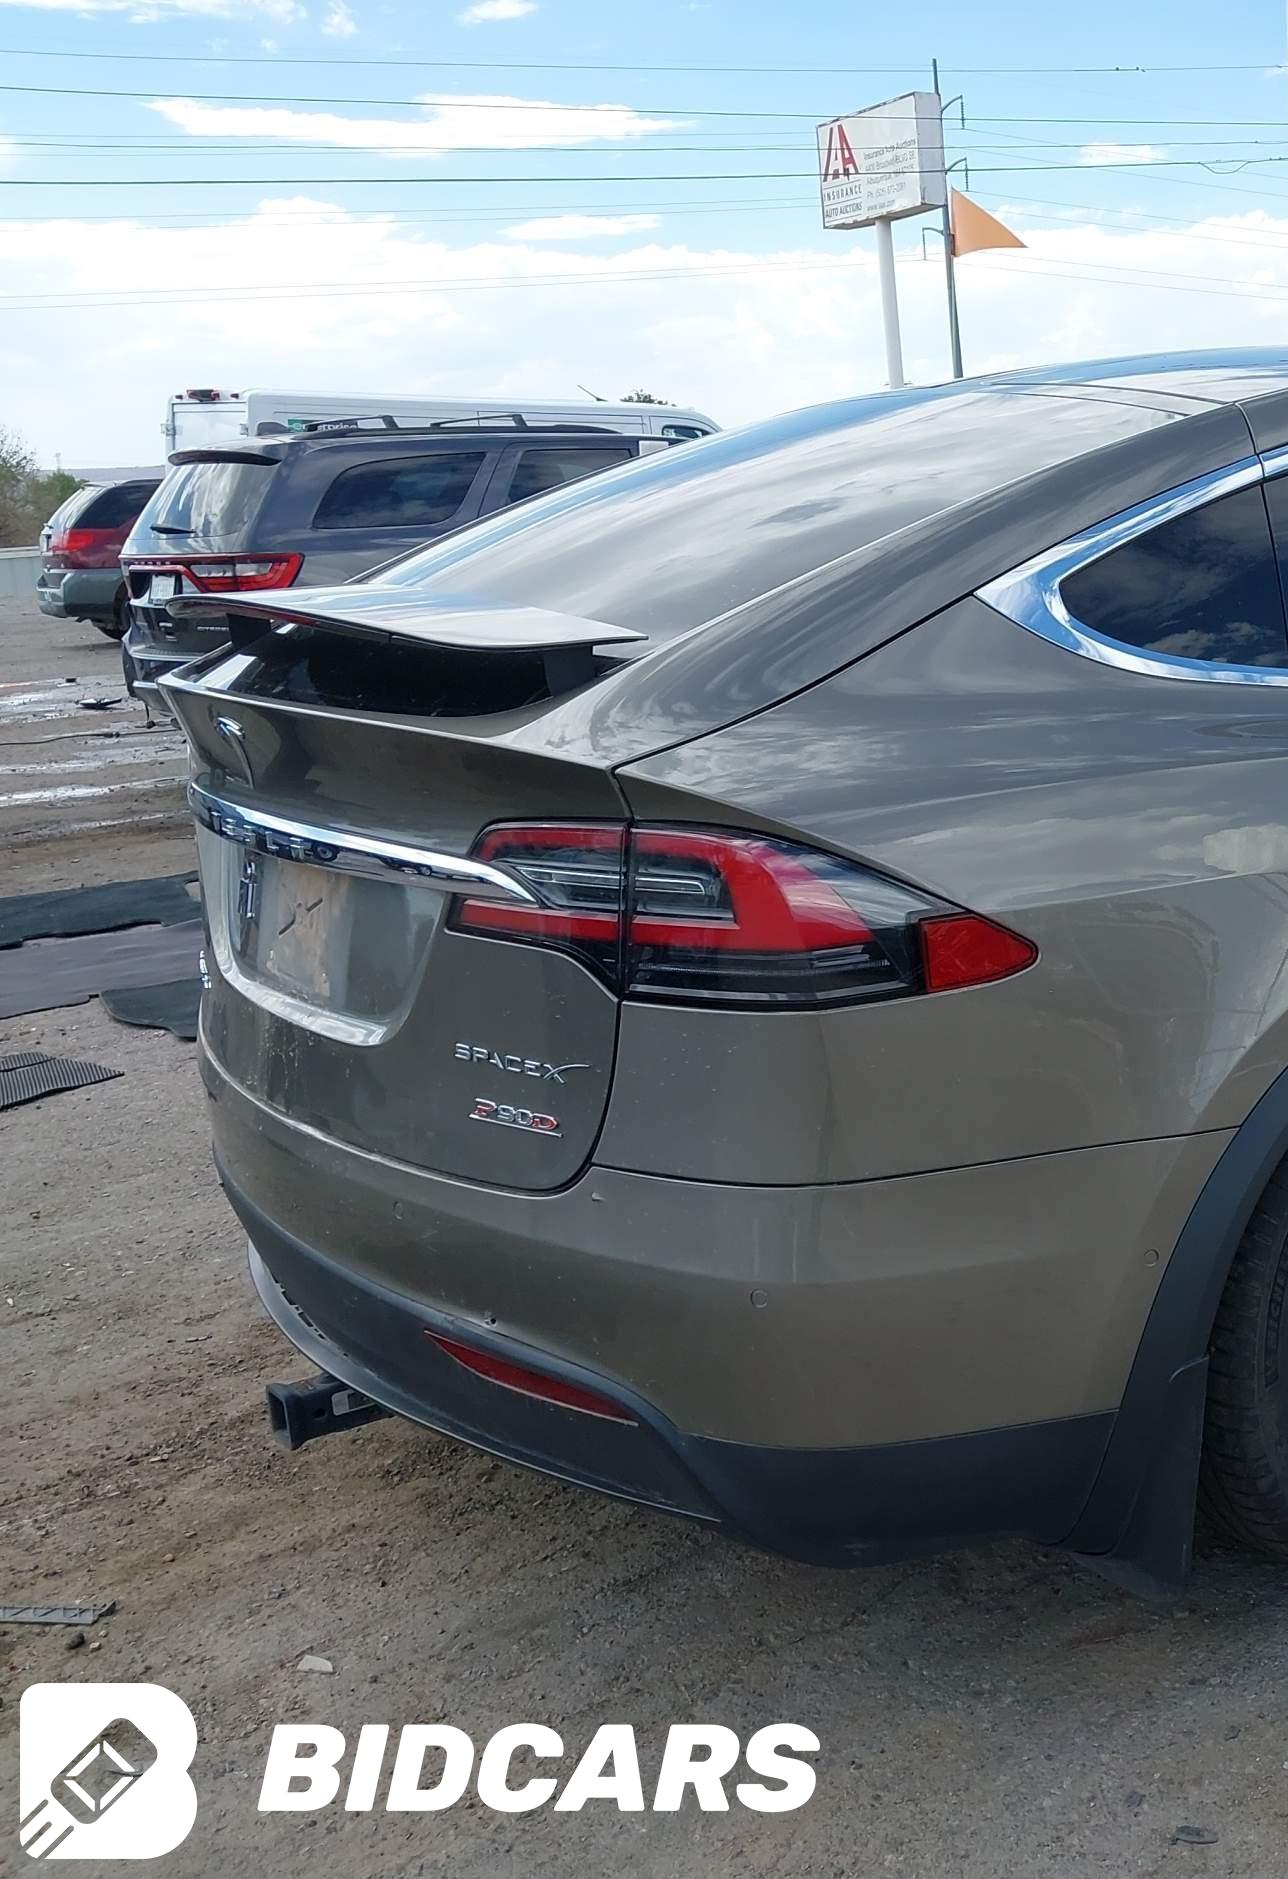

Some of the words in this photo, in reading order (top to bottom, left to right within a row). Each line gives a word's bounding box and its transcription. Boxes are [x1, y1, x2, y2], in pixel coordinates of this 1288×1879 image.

[823, 184, 862, 202] INSURANCE
[825, 206, 839, 218] AUTO
[839, 201, 863, 215] AUCTIONS
[454, 1042, 590, 1084] SPACEX
[473, 1097, 558, 1130] P90D
